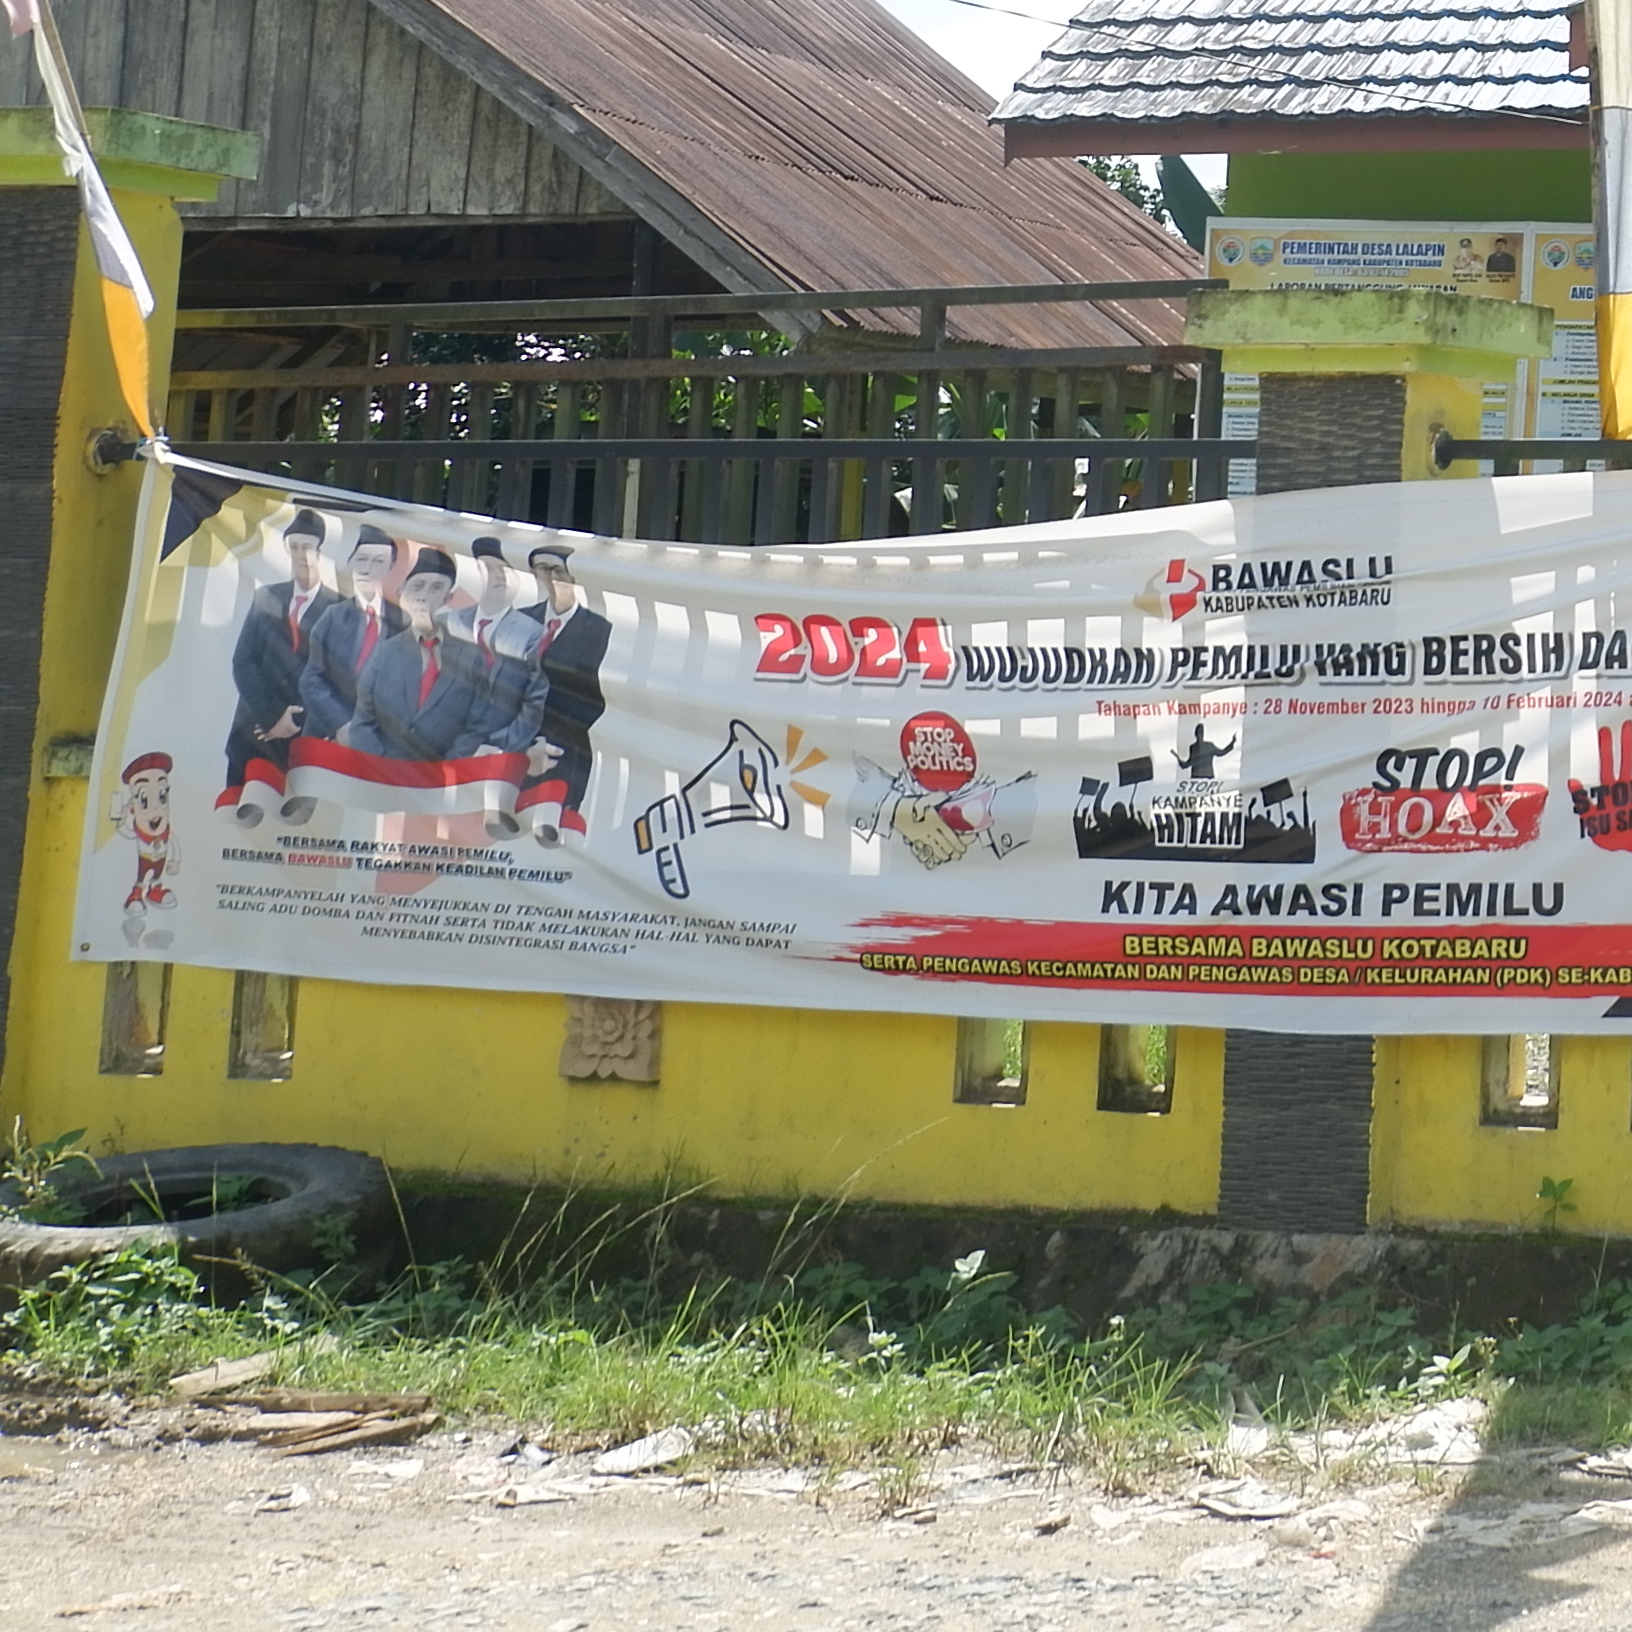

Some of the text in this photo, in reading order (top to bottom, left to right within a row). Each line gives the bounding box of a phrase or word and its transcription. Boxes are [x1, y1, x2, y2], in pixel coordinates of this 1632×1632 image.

[1281, 240, 1446, 258] PEMERINTAH DESA LALAPIN
[1362, 259, 1403, 267] KABUPATEN
[1203, 594, 1300, 613] KABUPATEN
[1305, 588, 1392, 608] KOTABARU
[754, 612, 955, 682] 2024
[961, 645, 1155, 685] WUJUDKAN
[1167, 643, 1301, 682] PEMILU
[1313, 640, 1407, 677] YANG
[1421, 632, 1565, 676] BERSIH
[1096, 700, 1161, 721] Tahapan
[1166, 699, 1248, 718] Kampanye
[1263, 698, 1282, 715] 28
[1287, 697, 1366, 715] November
[1372, 697, 1414, 714] 2023
[1420, 696, 1475, 717] hingga
[1506, 692, 1577, 709] Februari
[1583, 691, 1623, 707] 2024
[914, 726, 955, 742] STOP
[908, 741, 964, 756] MONEY
[907, 755, 974, 771] POLITICS
[1372, 743, 1525, 793] STOP!
[1151, 792, 1243, 809] KAMPANYE
[1155, 811, 1243, 846] HITAM
[1354, 791, 1523, 840] HOAX
[1579, 812, 1611, 839] ISU
[350, 839, 405, 854] RAKYAT
[408, 844, 453, 858] AWASI
[222, 848, 285, 863] BERSAMA
[288, 852, 352, 868] BAWASLU
[355, 857, 432, 873] TEGAKKAN
[435, 861, 505, 879] KEADILAN
[1100, 880, 1565, 917] KITA AWASI PEMILU
[217, 899, 792, 951] SALING ADU DOMBA DAN FITNAH SERTA TIDAK MELAKUKAN HAL-HAL YANG DAPAT
[349, 893, 386, 906] YANG
[389, 896, 490, 913] MENYEJUKKAN
[493, 903, 512, 915] DI
[515, 904, 574, 919] TENGAH
[683, 915, 736, 931] JANGAN
[739, 920, 797, 935] SAMPAI
[360, 925, 464, 944] MENYEBABKAN
[467, 933, 565, 951] DISINTEGRASI
[1124, 934, 1527, 960] BERSAMA BAWASLU KOTABARU
[861, 953, 918, 971] SERTA
[921, 956, 1023, 976] PENGAWAS
[1027, 960, 1141, 979] KECAMATAN
[1145, 964, 1184, 979] DAN
[1188, 964, 1294, 984] PENGAWAS
[1299, 966, 1350, 985] DESA
[1353, 966, 1361, 984] /
[1366, 966, 1491, 985] KELURAHAN
[1495, 967, 1551, 988] (PDK)
